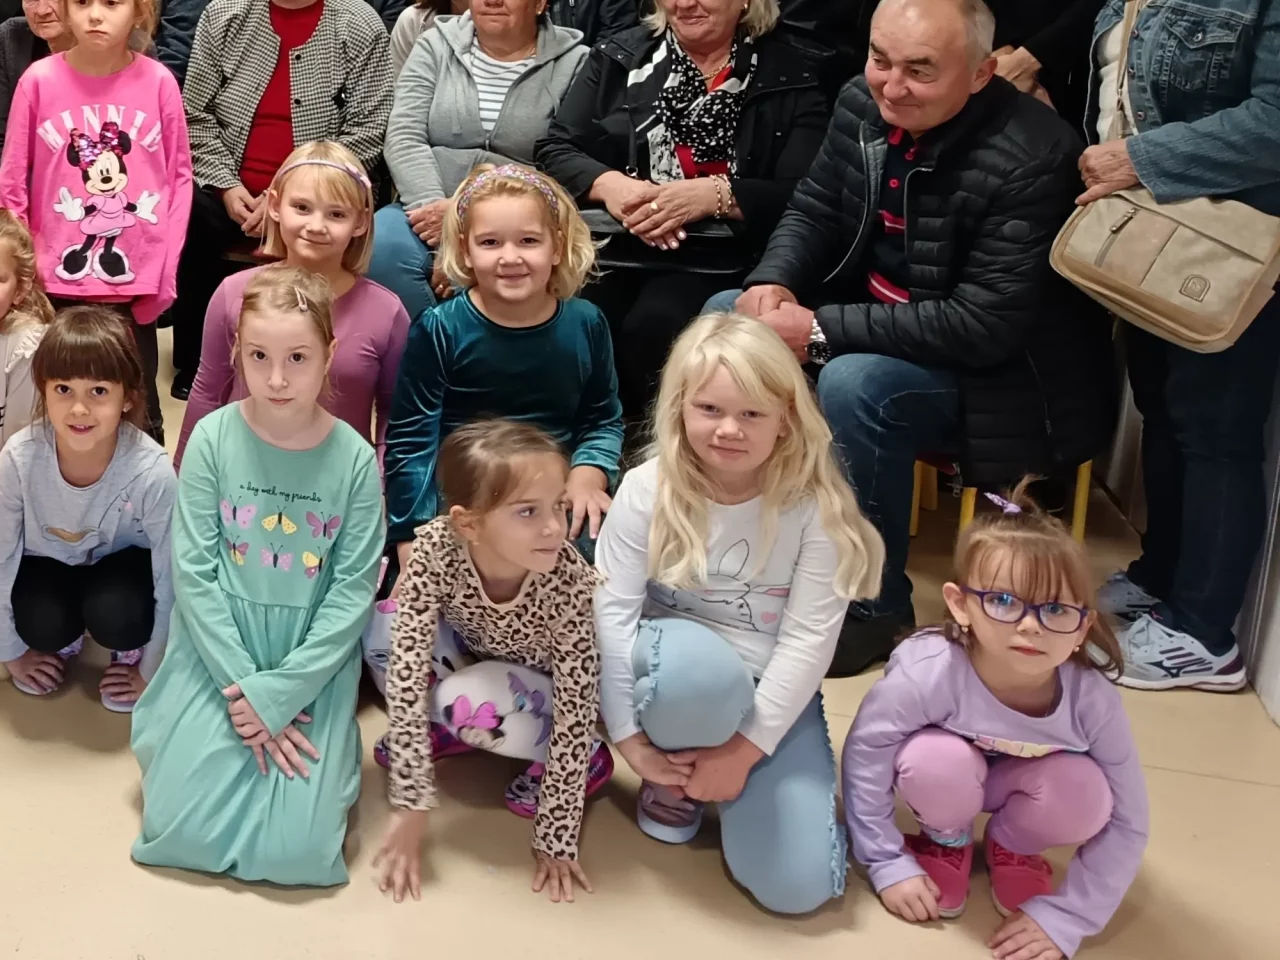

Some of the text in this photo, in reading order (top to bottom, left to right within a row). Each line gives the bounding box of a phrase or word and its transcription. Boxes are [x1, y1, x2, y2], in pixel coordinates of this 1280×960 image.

[247, 481, 260, 497] day
[261, 485, 278, 497] with
[279, 490, 291, 502] my
